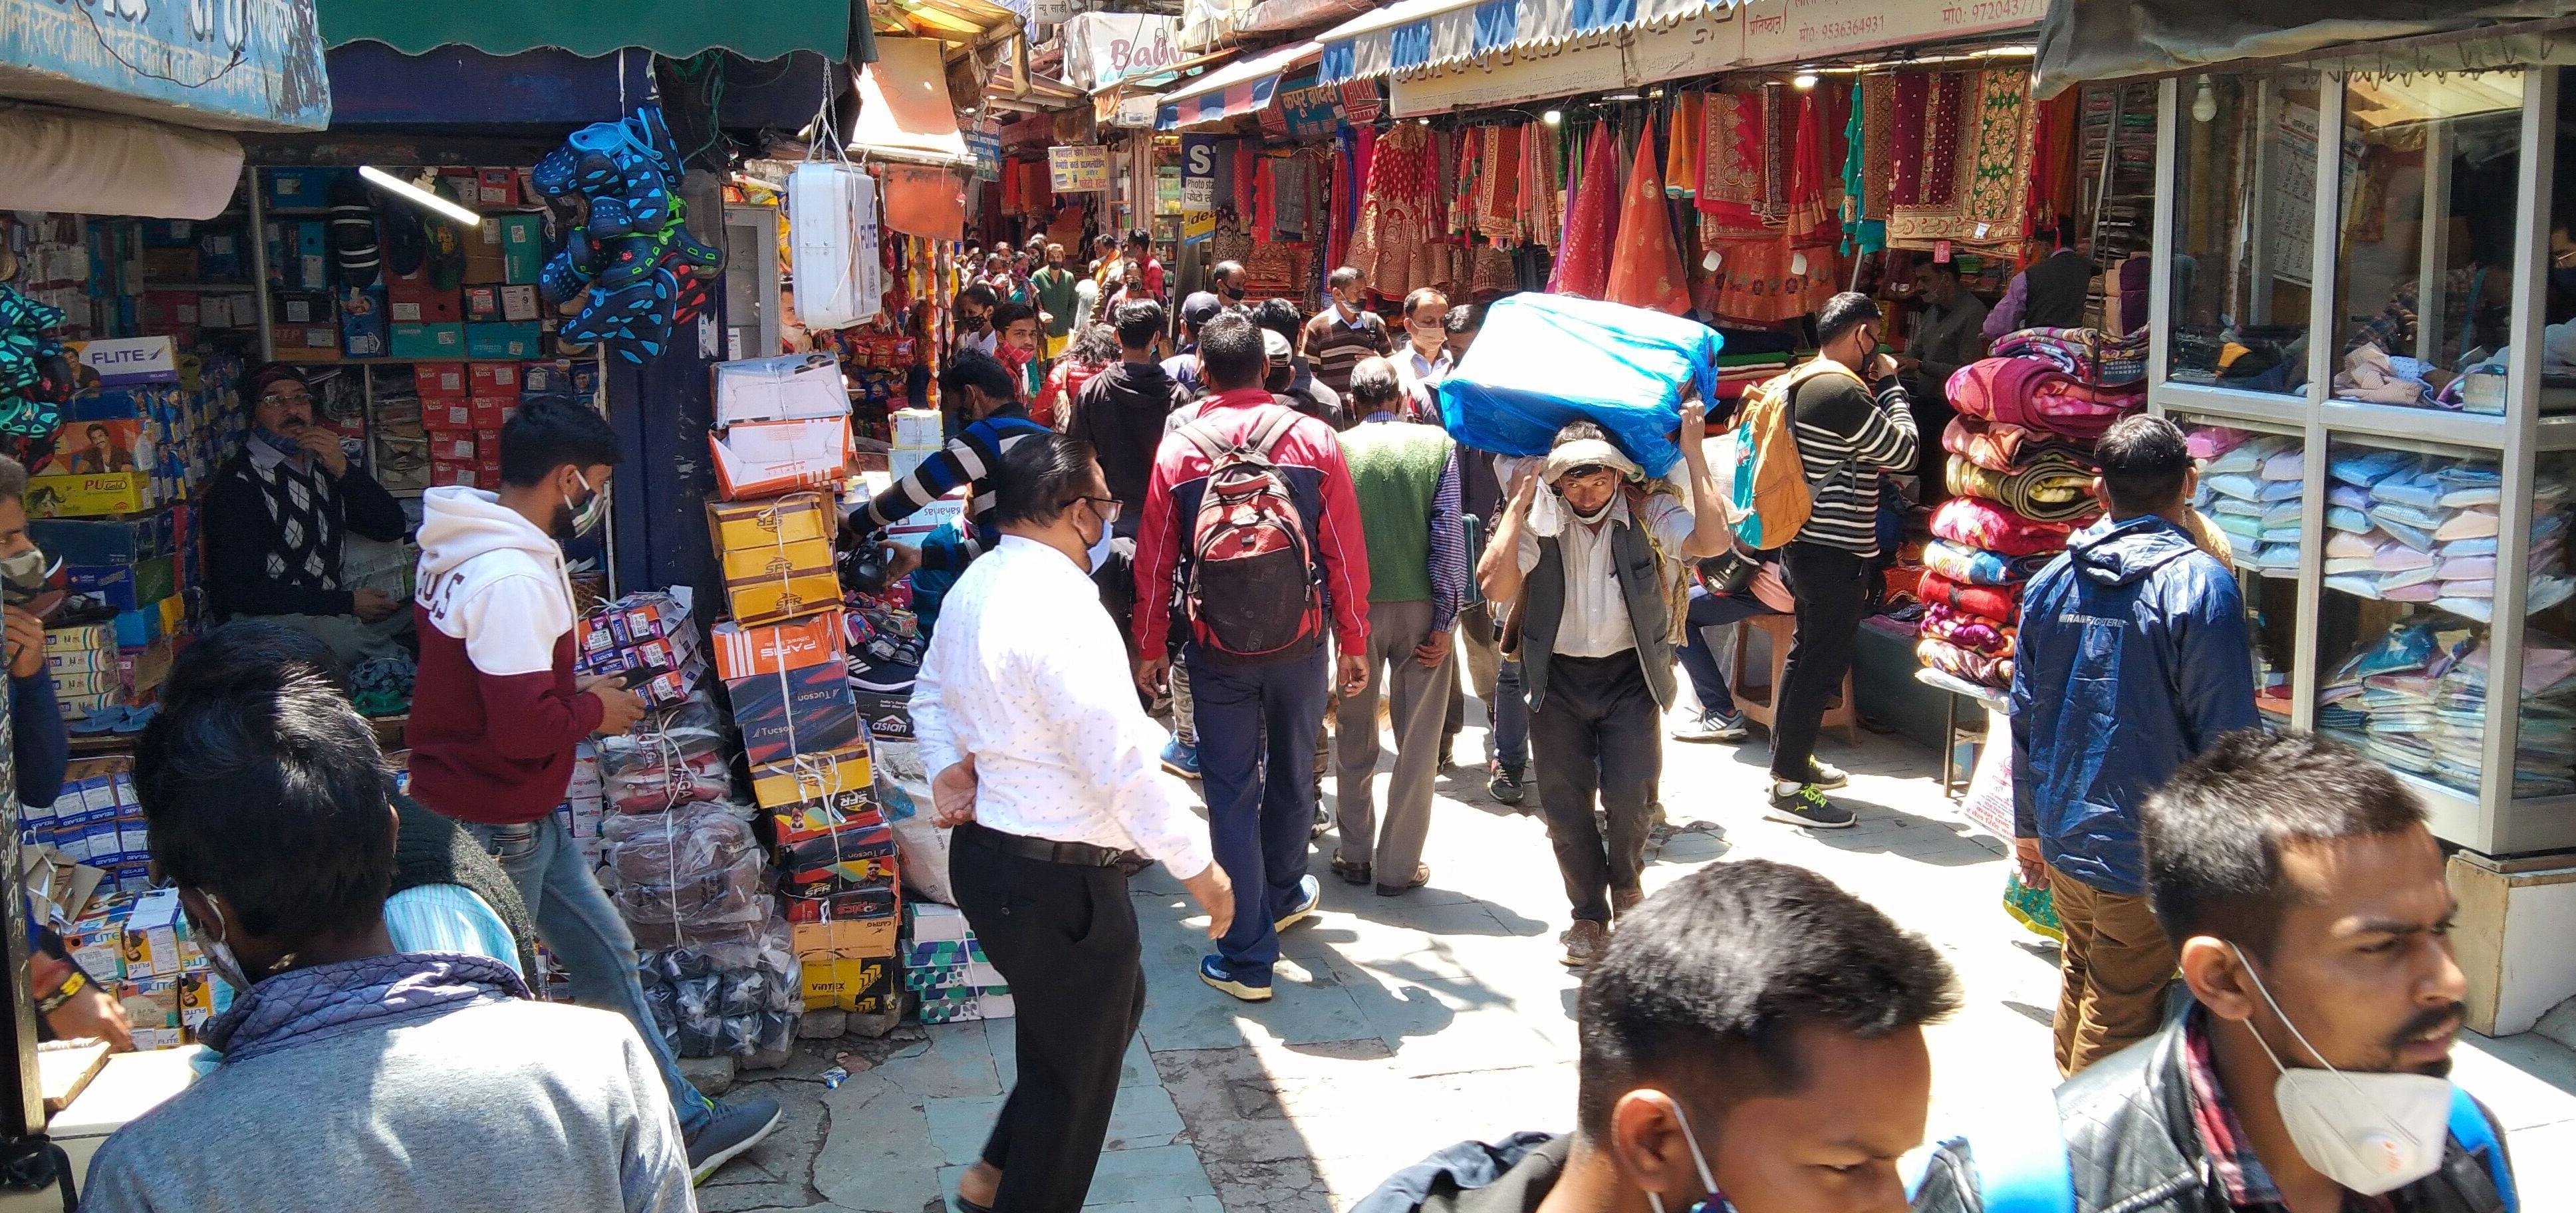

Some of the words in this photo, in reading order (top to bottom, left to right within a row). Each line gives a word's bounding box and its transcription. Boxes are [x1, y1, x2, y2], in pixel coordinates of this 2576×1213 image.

[1187, 179, 1204, 190] Photo
[860, 223, 878, 249] FLITE
[92, 349, 145, 364] FLITE
[84, 479, 104, 491] PU
[766, 562, 793, 574] SFR
[775, 597, 803, 610] SFR
[798, 690, 831, 702] Tucson
[761, 725, 795, 736] Tucson
[872, 722, 907, 734] asian
[840, 793, 867, 807] SFR
[63, 816, 86, 827] RELAXO
[92, 811, 114, 820] RELAXO
[848, 849, 878, 859] Tucson
[95, 857, 119, 865] RELAXO
[805, 883, 831, 898] SFR
